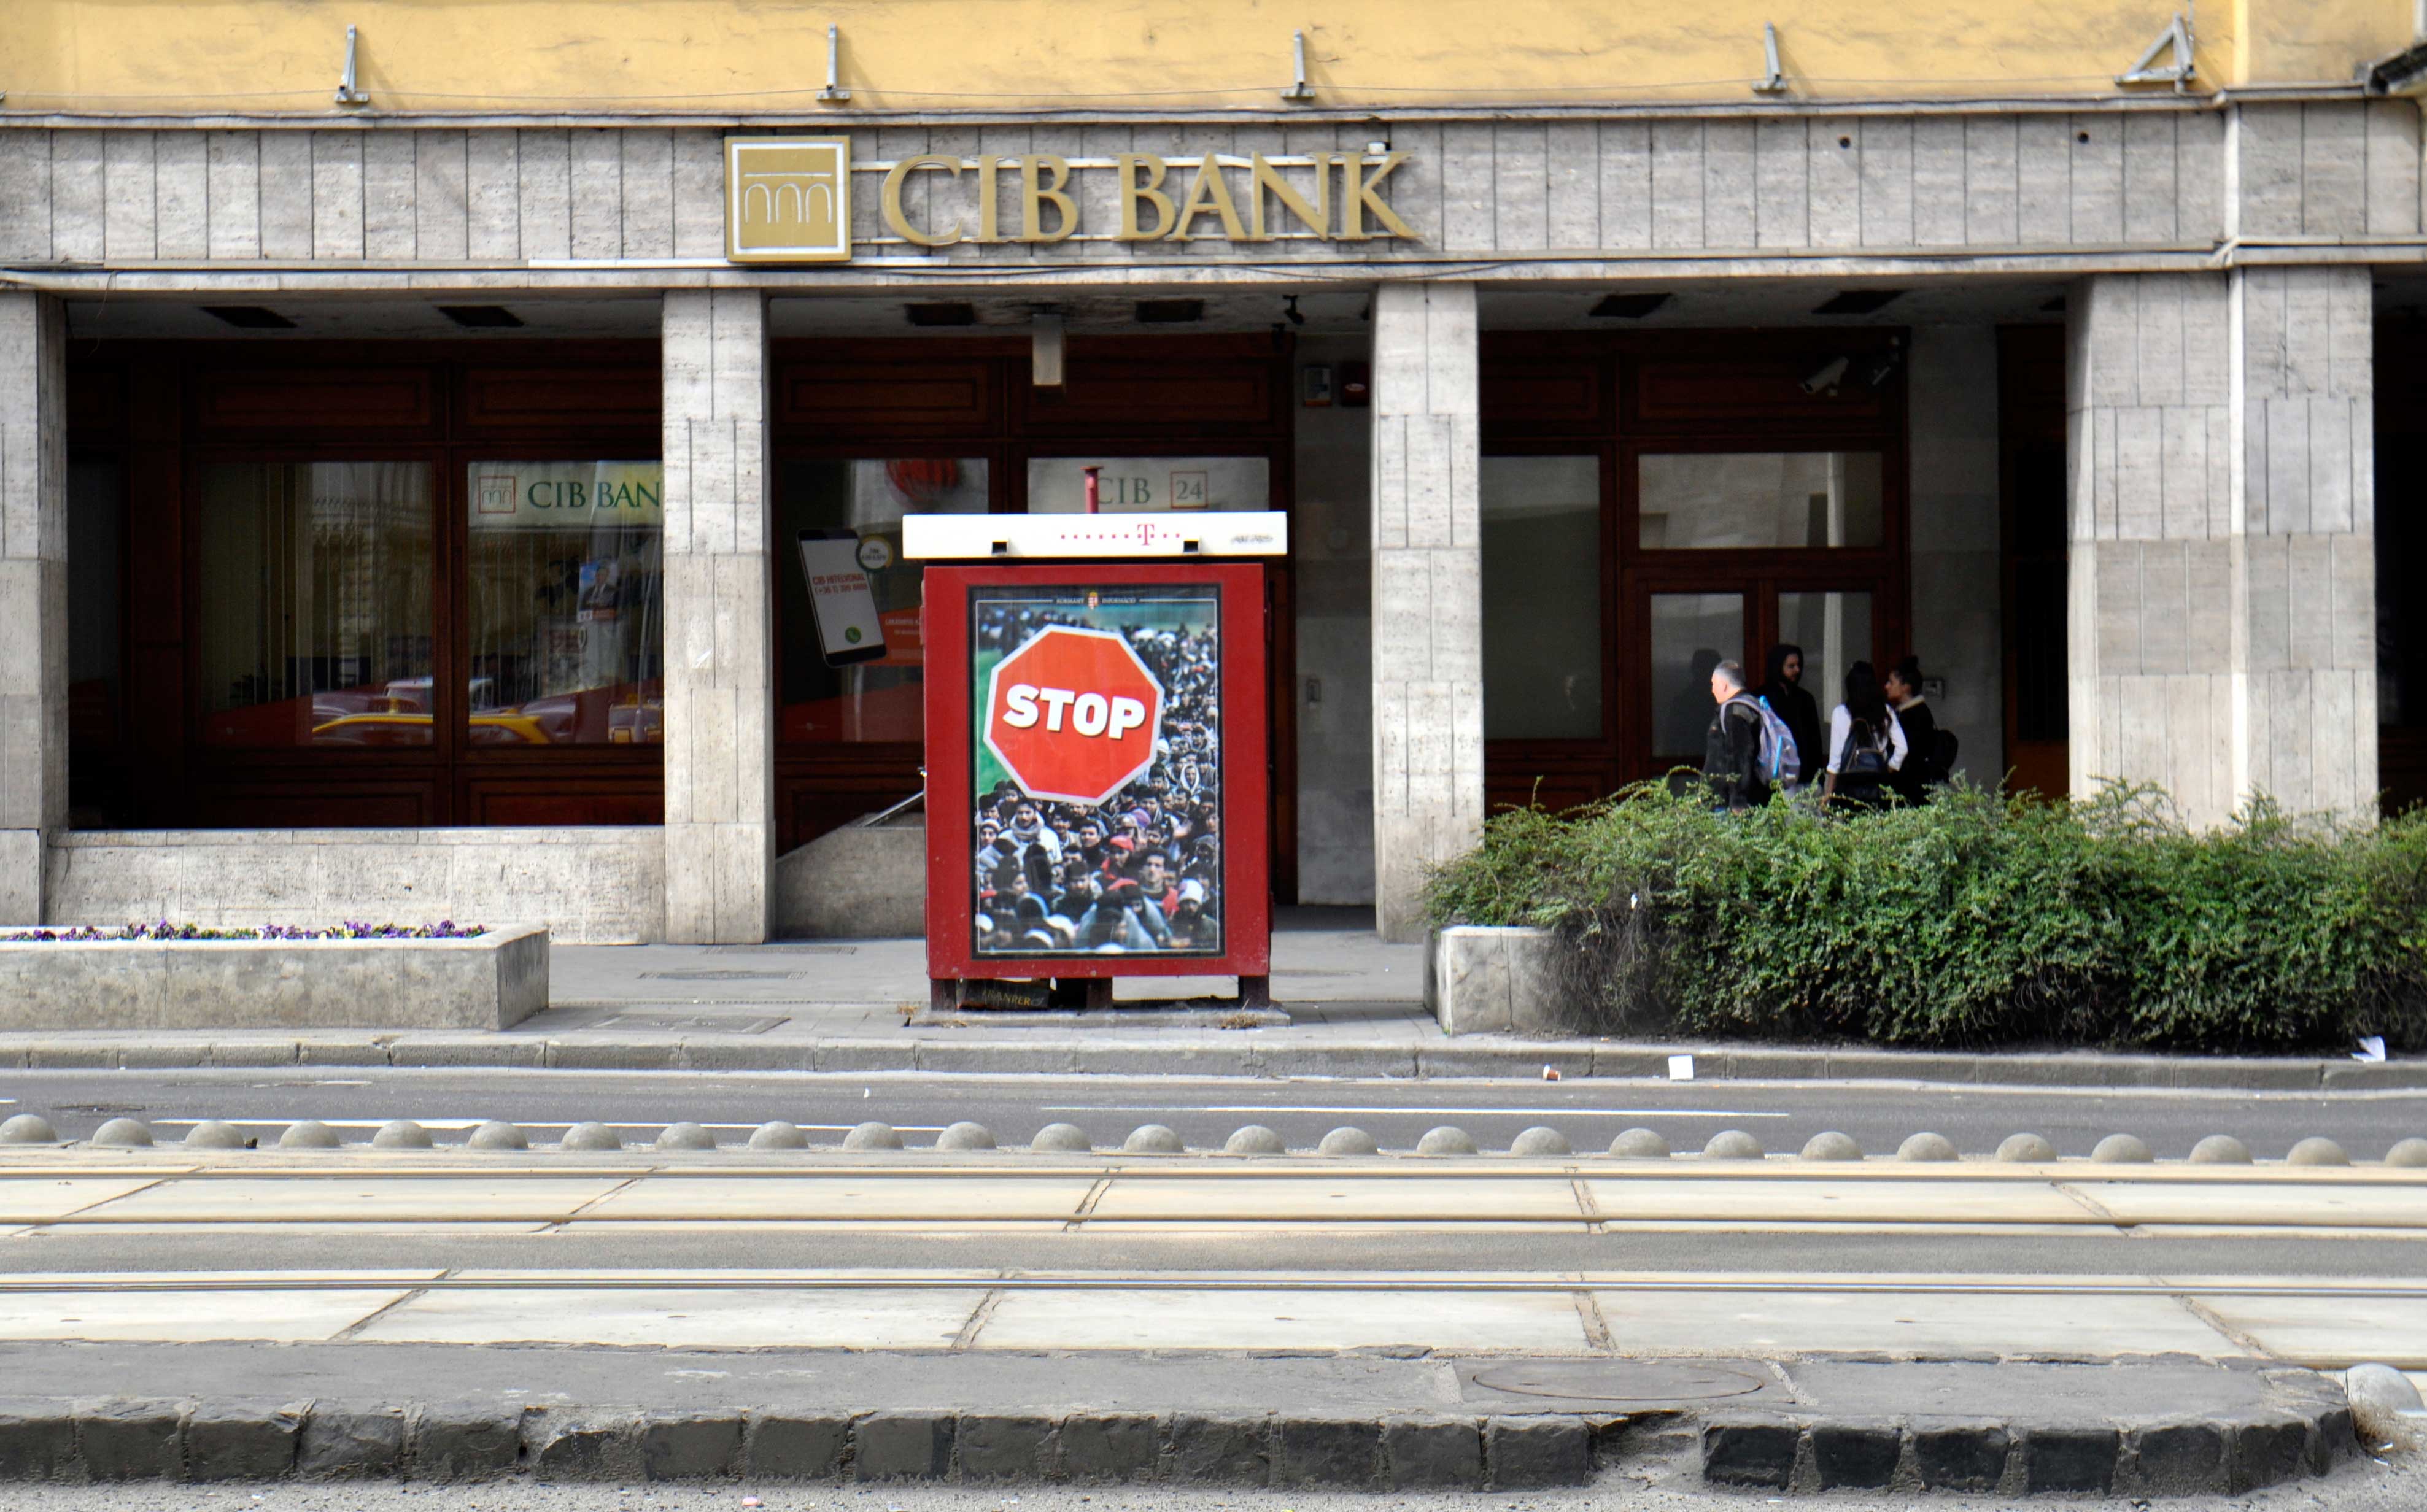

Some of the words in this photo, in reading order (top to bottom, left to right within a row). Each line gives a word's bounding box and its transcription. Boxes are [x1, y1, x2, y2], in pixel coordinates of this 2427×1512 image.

[881, 153, 1079, 245] CIB
[1112, 150, 1423, 242] BANK
[528, 481, 586, 508] CIB
[597, 481, 660, 507] BAN
[1097, 476, 1151, 504] CIB
[1176, 480, 1203, 500] 24
[1002, 684, 1146, 740] STOP
